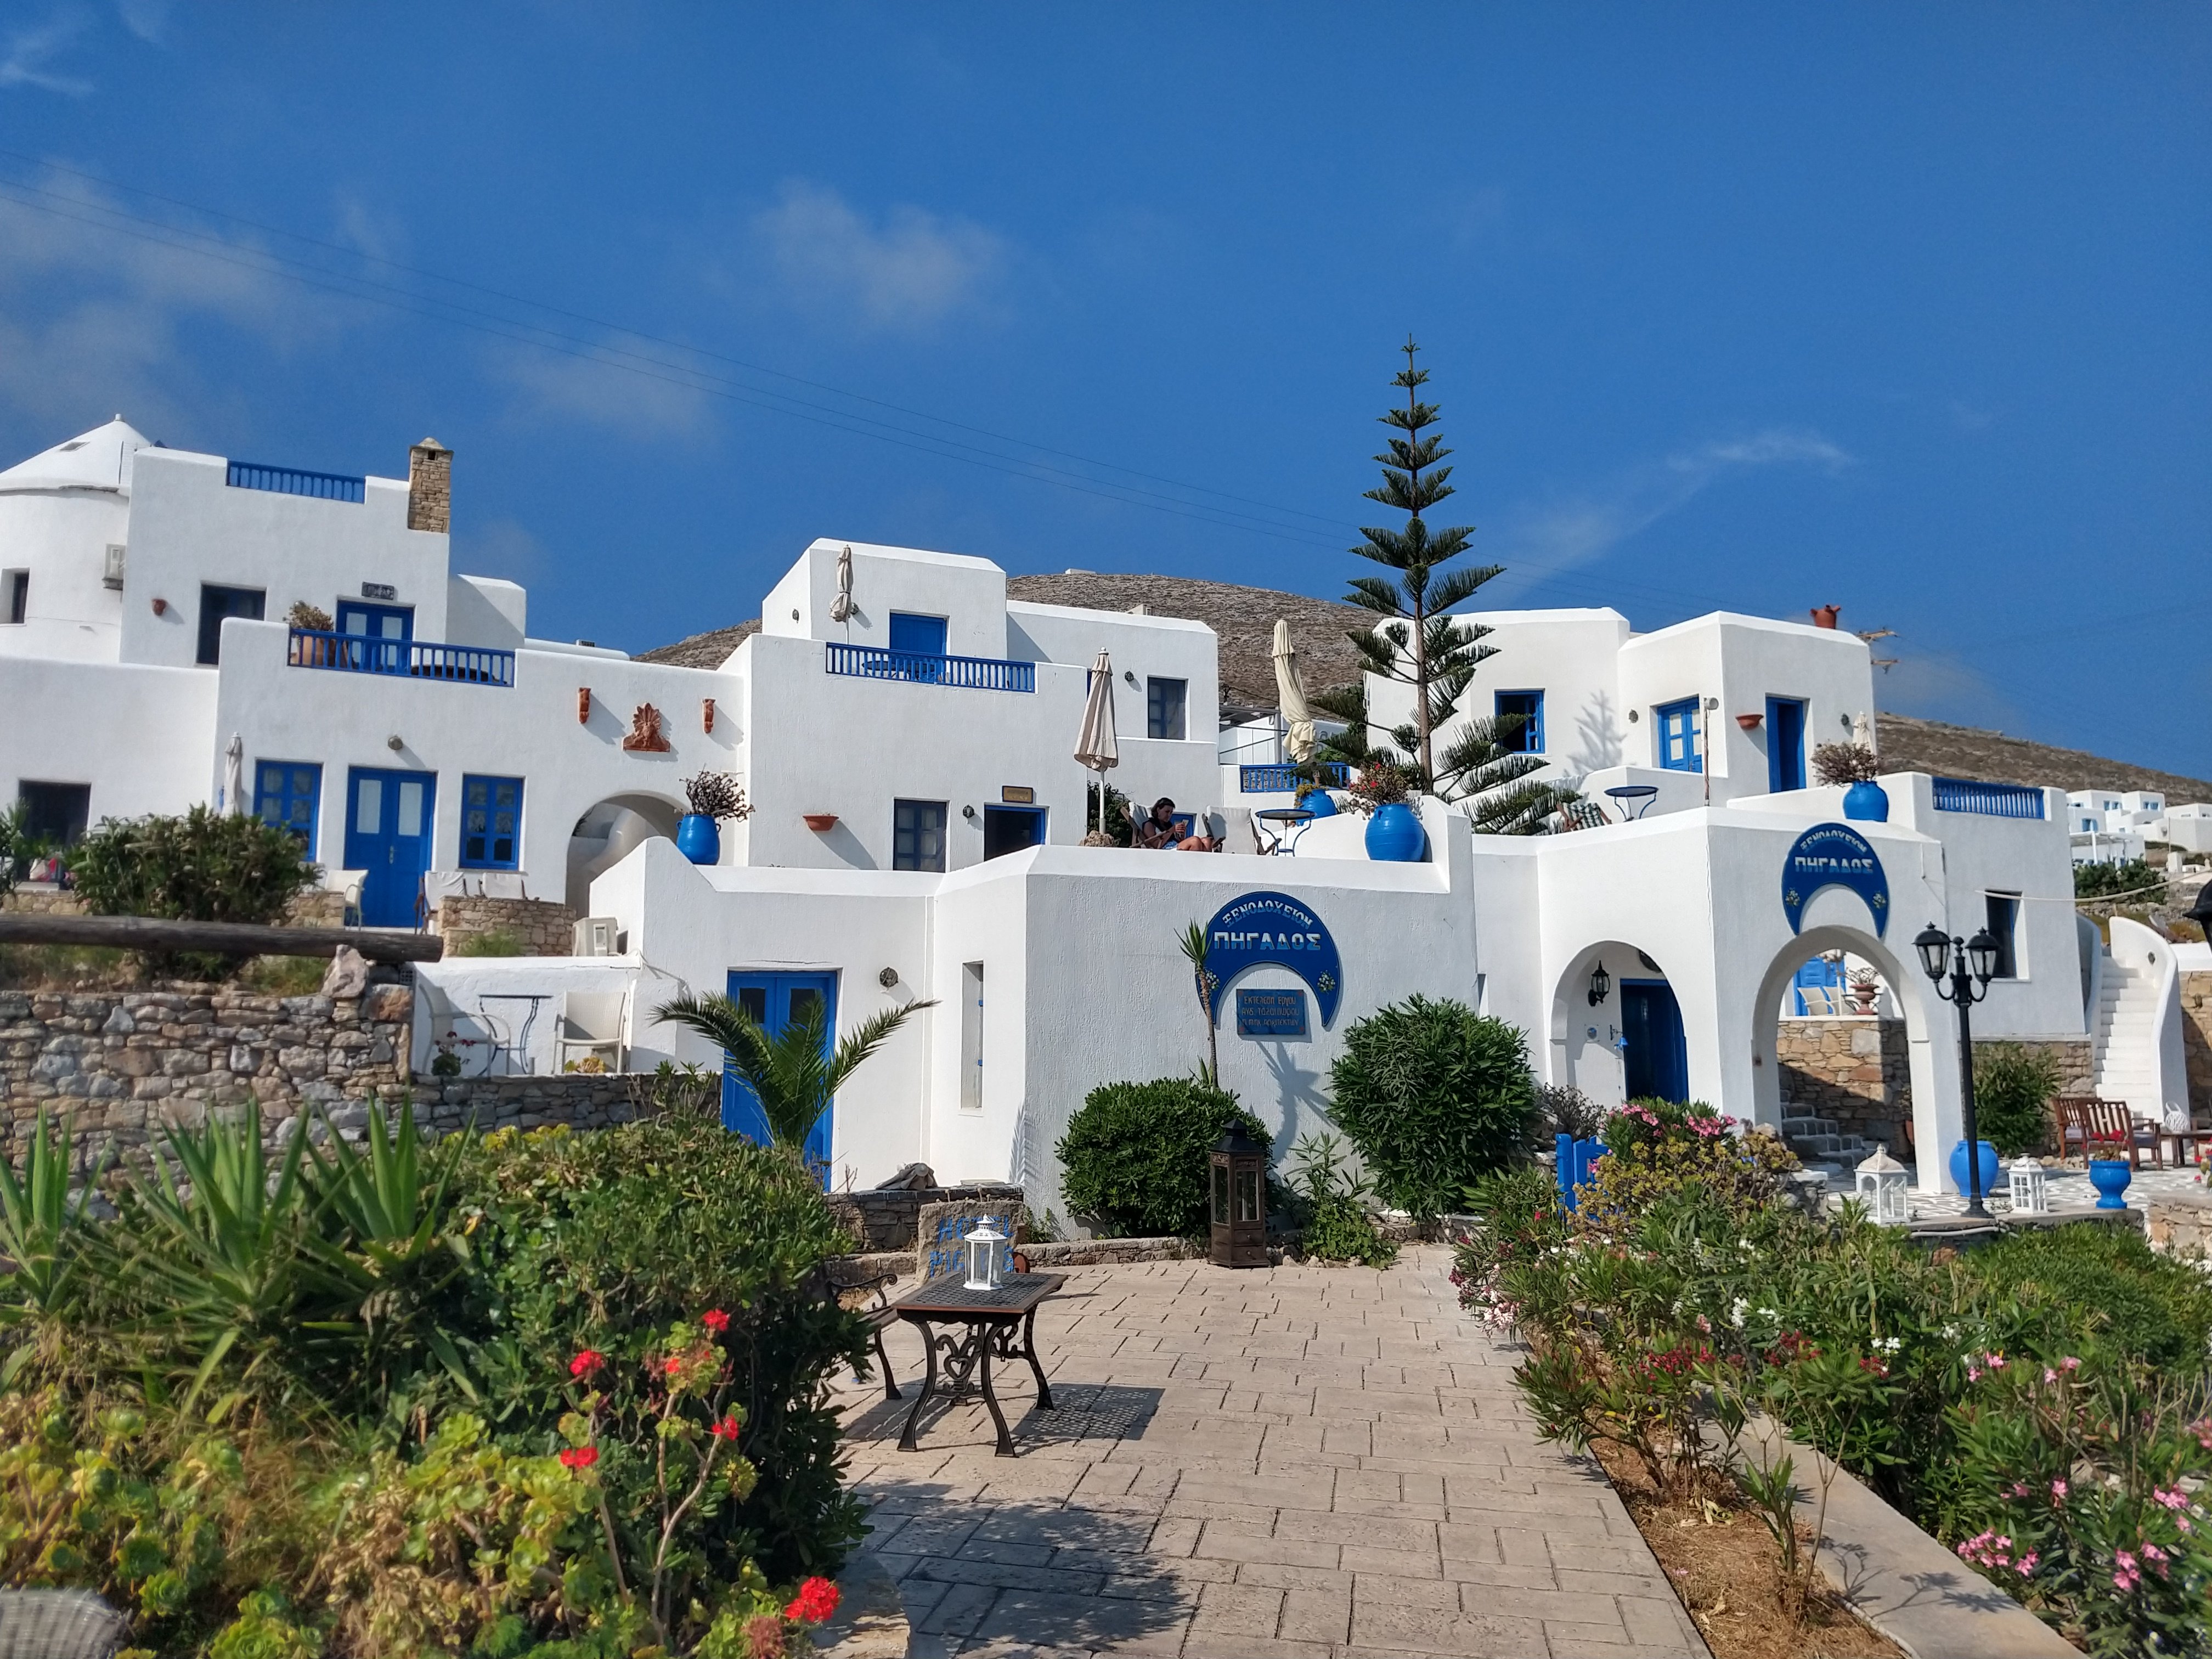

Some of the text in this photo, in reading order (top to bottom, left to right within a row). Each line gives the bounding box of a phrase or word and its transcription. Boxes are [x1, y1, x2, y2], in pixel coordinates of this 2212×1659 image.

[1795, 856, 1873, 873] ΠΗΓΑΔΟΣ
[1222, 900, 1313, 929] ΞΕΝΟΔΟΧΕΙΟΝ
[1214, 932, 1321, 950] ΠΗΓΑΔΟΣ
[930, 1246, 1014, 1278] PIGS
